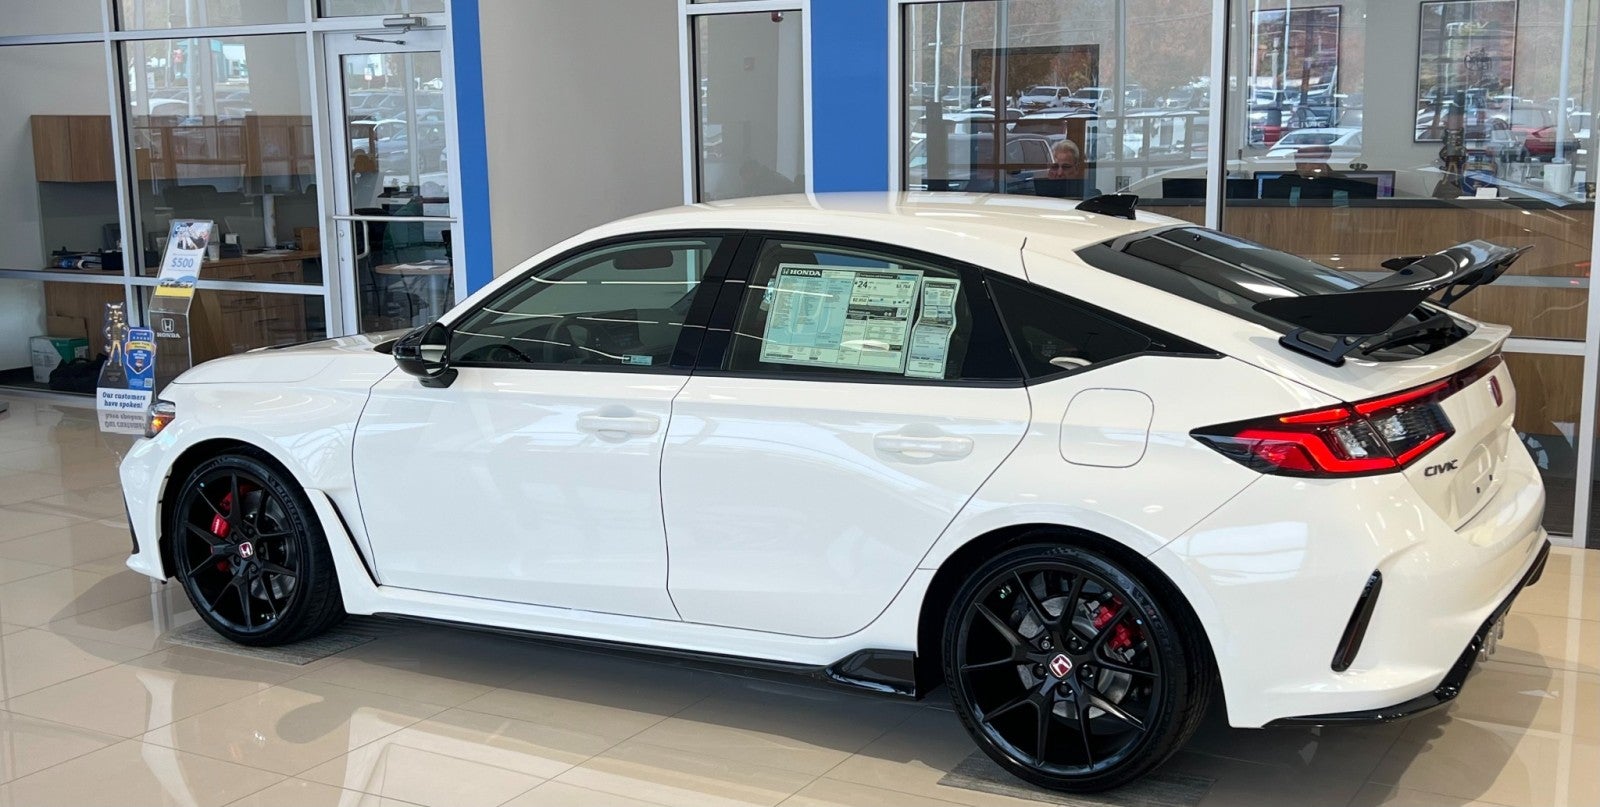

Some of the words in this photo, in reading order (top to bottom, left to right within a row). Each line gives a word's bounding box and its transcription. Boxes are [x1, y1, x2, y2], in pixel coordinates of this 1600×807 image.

[171, 257, 194, 268] $500
[790, 268, 821, 277] HONDA
[1424, 459, 1458, 477] CIVIC
